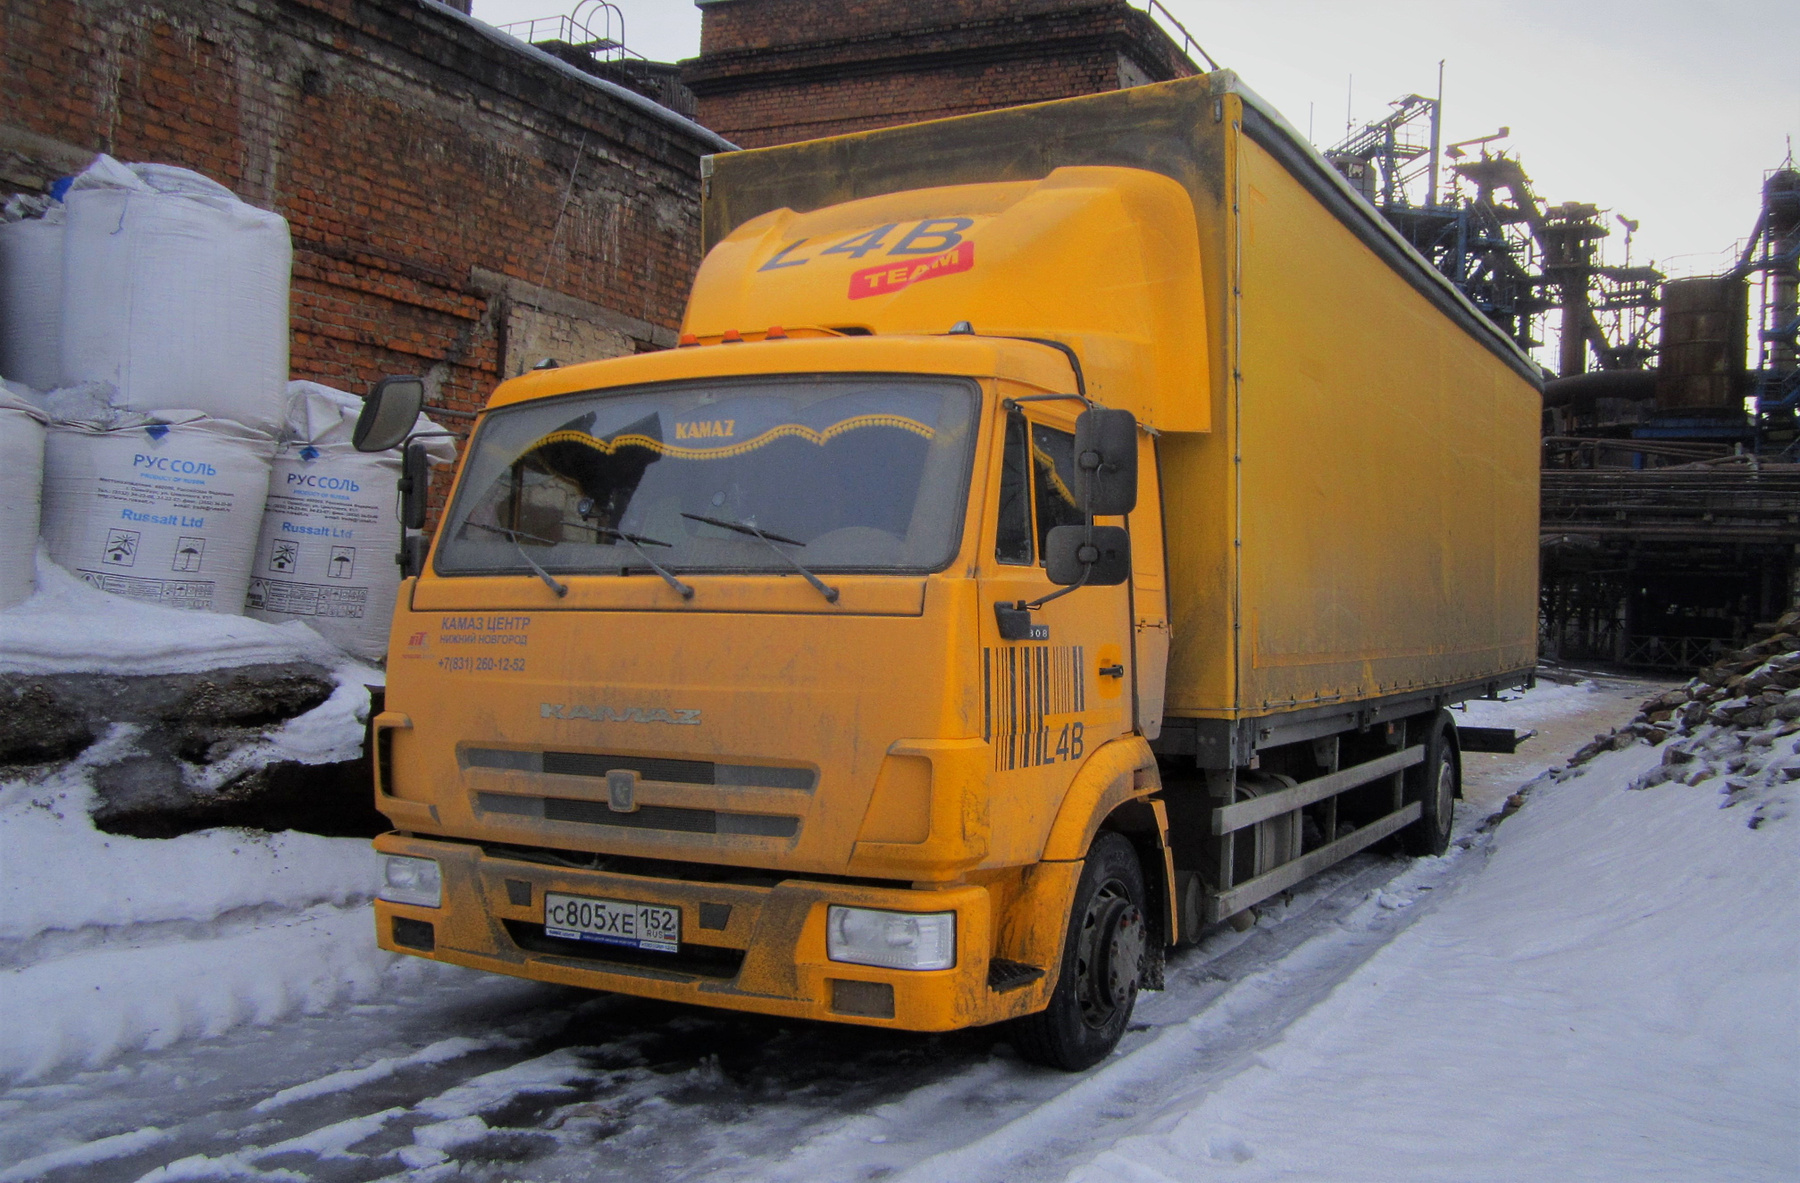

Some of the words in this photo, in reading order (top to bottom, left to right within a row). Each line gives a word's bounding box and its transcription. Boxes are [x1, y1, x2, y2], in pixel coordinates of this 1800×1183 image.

[864, 250, 960, 288] TEAM
[675, 419, 735, 439] KAMAZ
[122, 508, 178, 526] Russalt
[181, 515, 204, 528] Ltd
[282, 522, 329, 536] Russalt
[332, 527, 354, 539] Ltd
[441, 617, 484, 630] КАМАЗ
[487, 617, 531, 632] ЦЕНТР
[440, 633, 476, 644] НИЖНИЙ
[479, 634, 528, 645] НОВГОРОД
[438, 657, 473, 673] +7(831)
[476, 657, 526, 671] 260-12-52
[1043, 721, 1084, 764] L4B
[640, 908, 673, 931] 152
[646, 929, 664, 939] RUS
